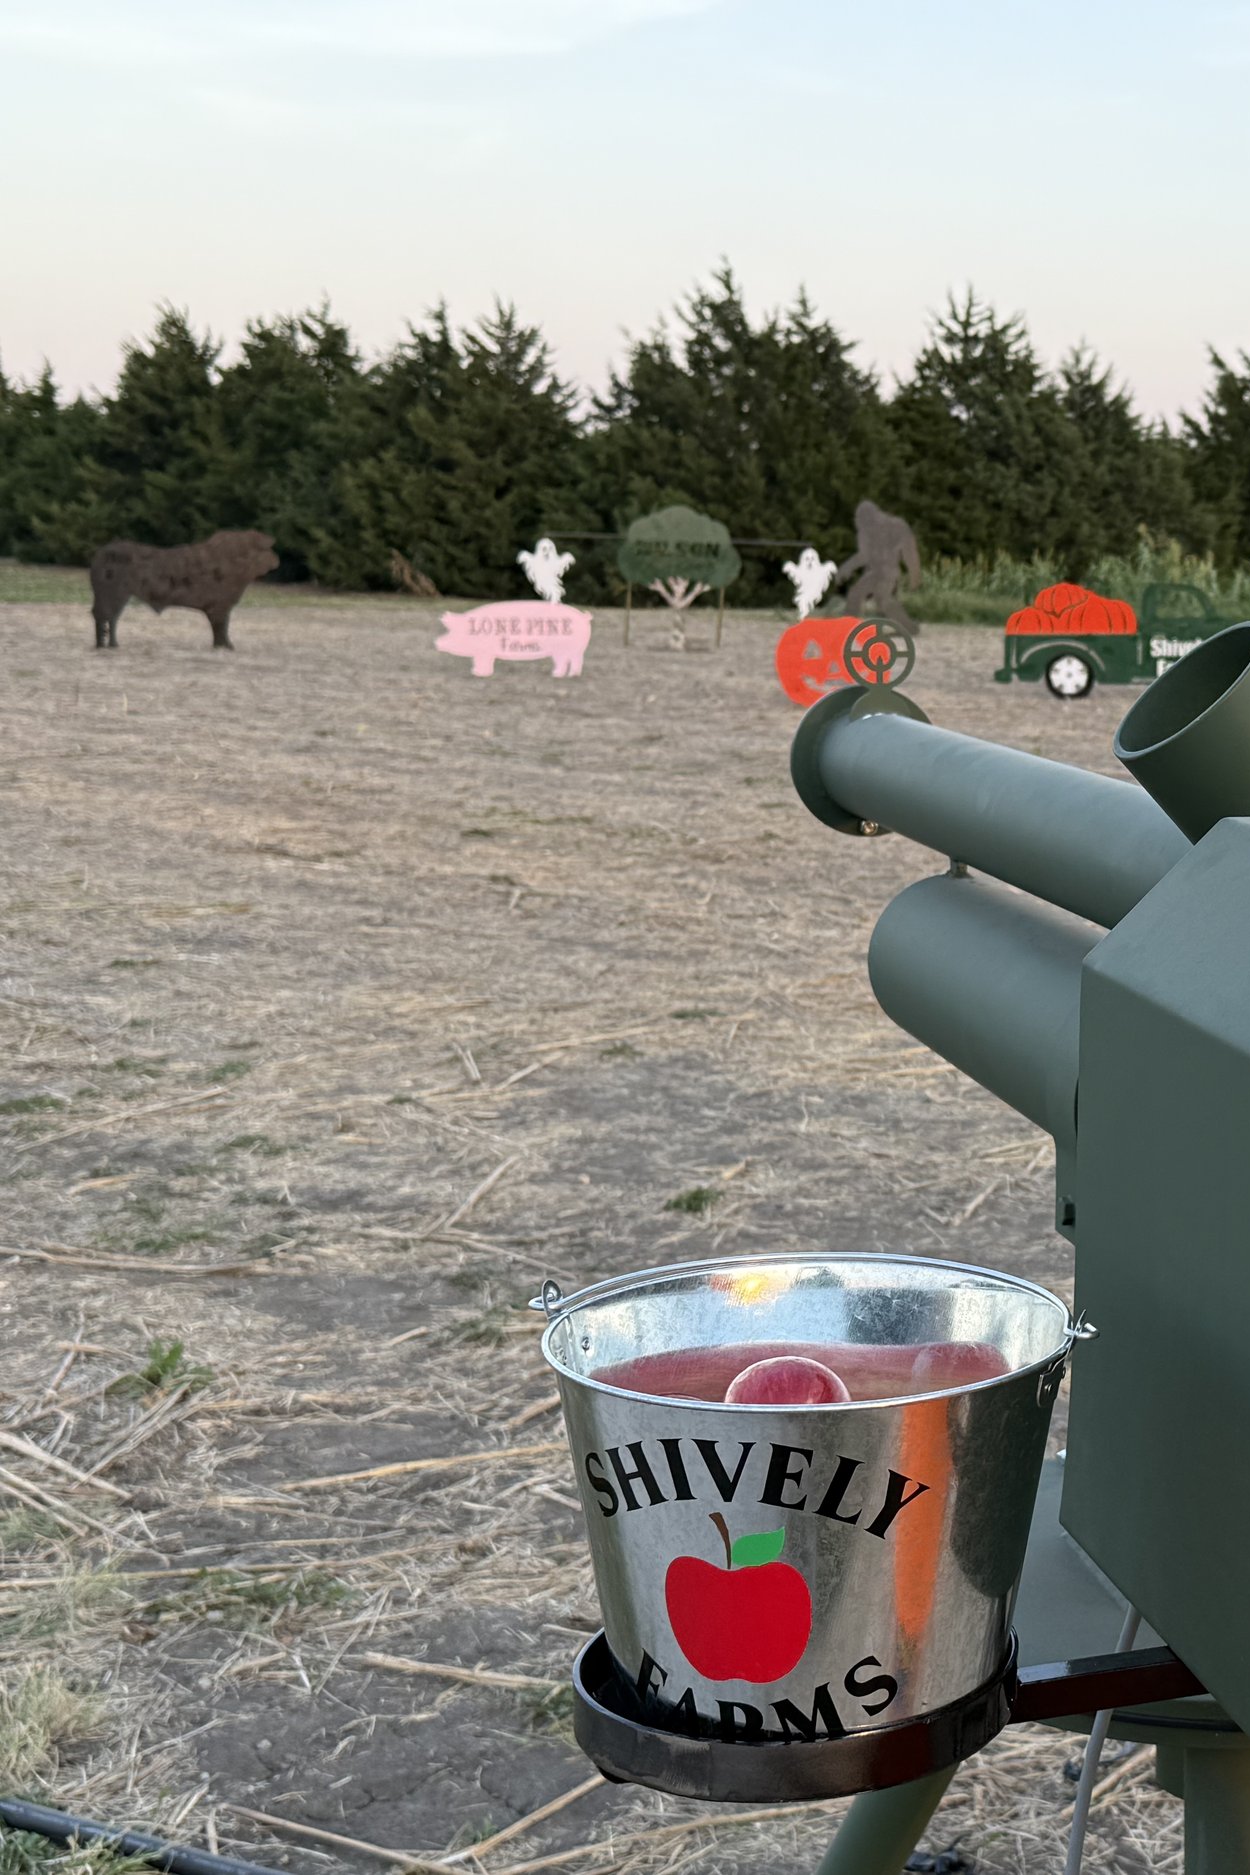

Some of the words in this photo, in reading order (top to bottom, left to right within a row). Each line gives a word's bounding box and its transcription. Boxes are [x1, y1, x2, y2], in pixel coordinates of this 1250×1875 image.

[468, 616, 521, 636] LONE
[526, 616, 574, 636] PINE
[585, 1437, 931, 1541] SHIVELY
